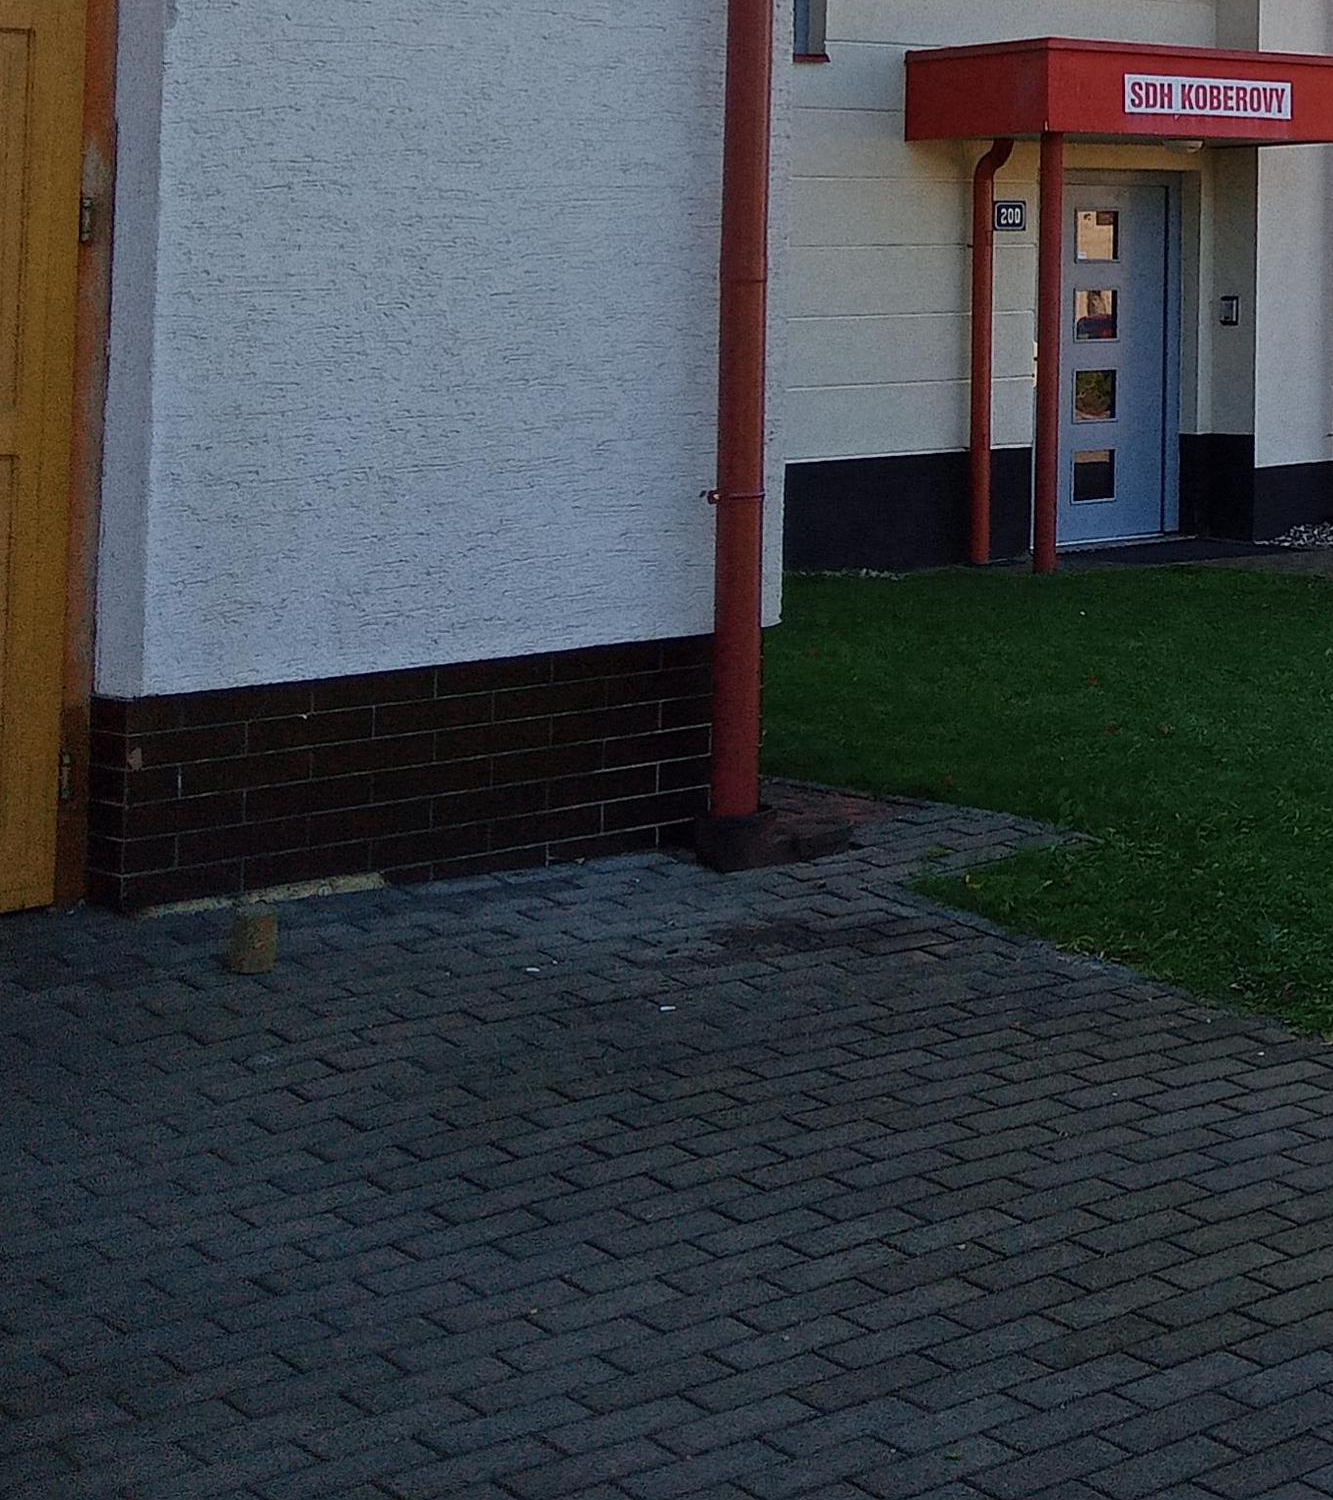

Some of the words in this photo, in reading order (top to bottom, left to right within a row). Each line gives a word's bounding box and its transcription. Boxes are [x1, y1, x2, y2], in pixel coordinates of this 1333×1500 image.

[1130, 81, 1173, 109] SDH
[1181, 83, 1286, 114] KOBEROVY
[1000, 207, 1021, 225] 200
